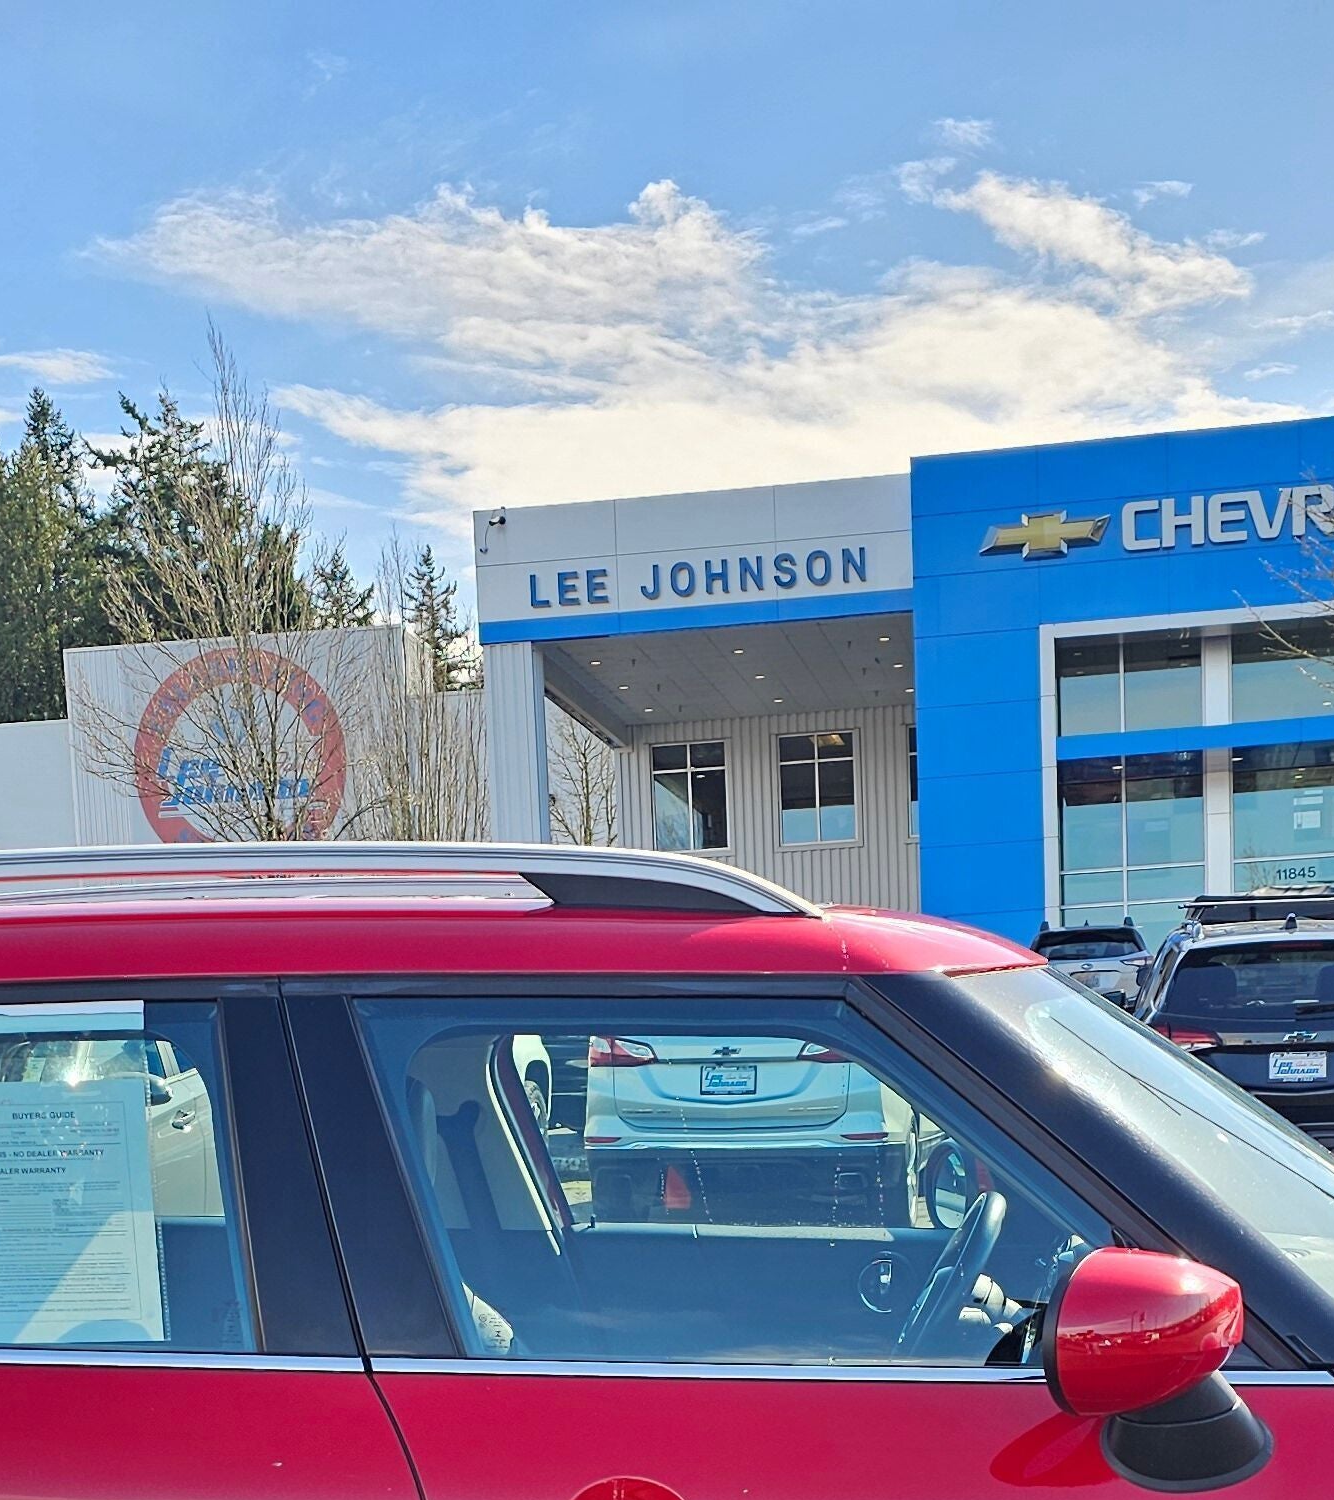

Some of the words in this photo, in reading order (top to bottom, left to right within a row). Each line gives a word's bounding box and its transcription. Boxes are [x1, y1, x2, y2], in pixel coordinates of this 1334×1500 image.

[529, 568, 610, 608] LEE
[640, 547, 868, 600] JOHNSON
[1276, 866, 1316, 880] 11845
[12, 1111, 47, 1120] BUYERS
[21, 1166, 67, 1175] WARRANTY
